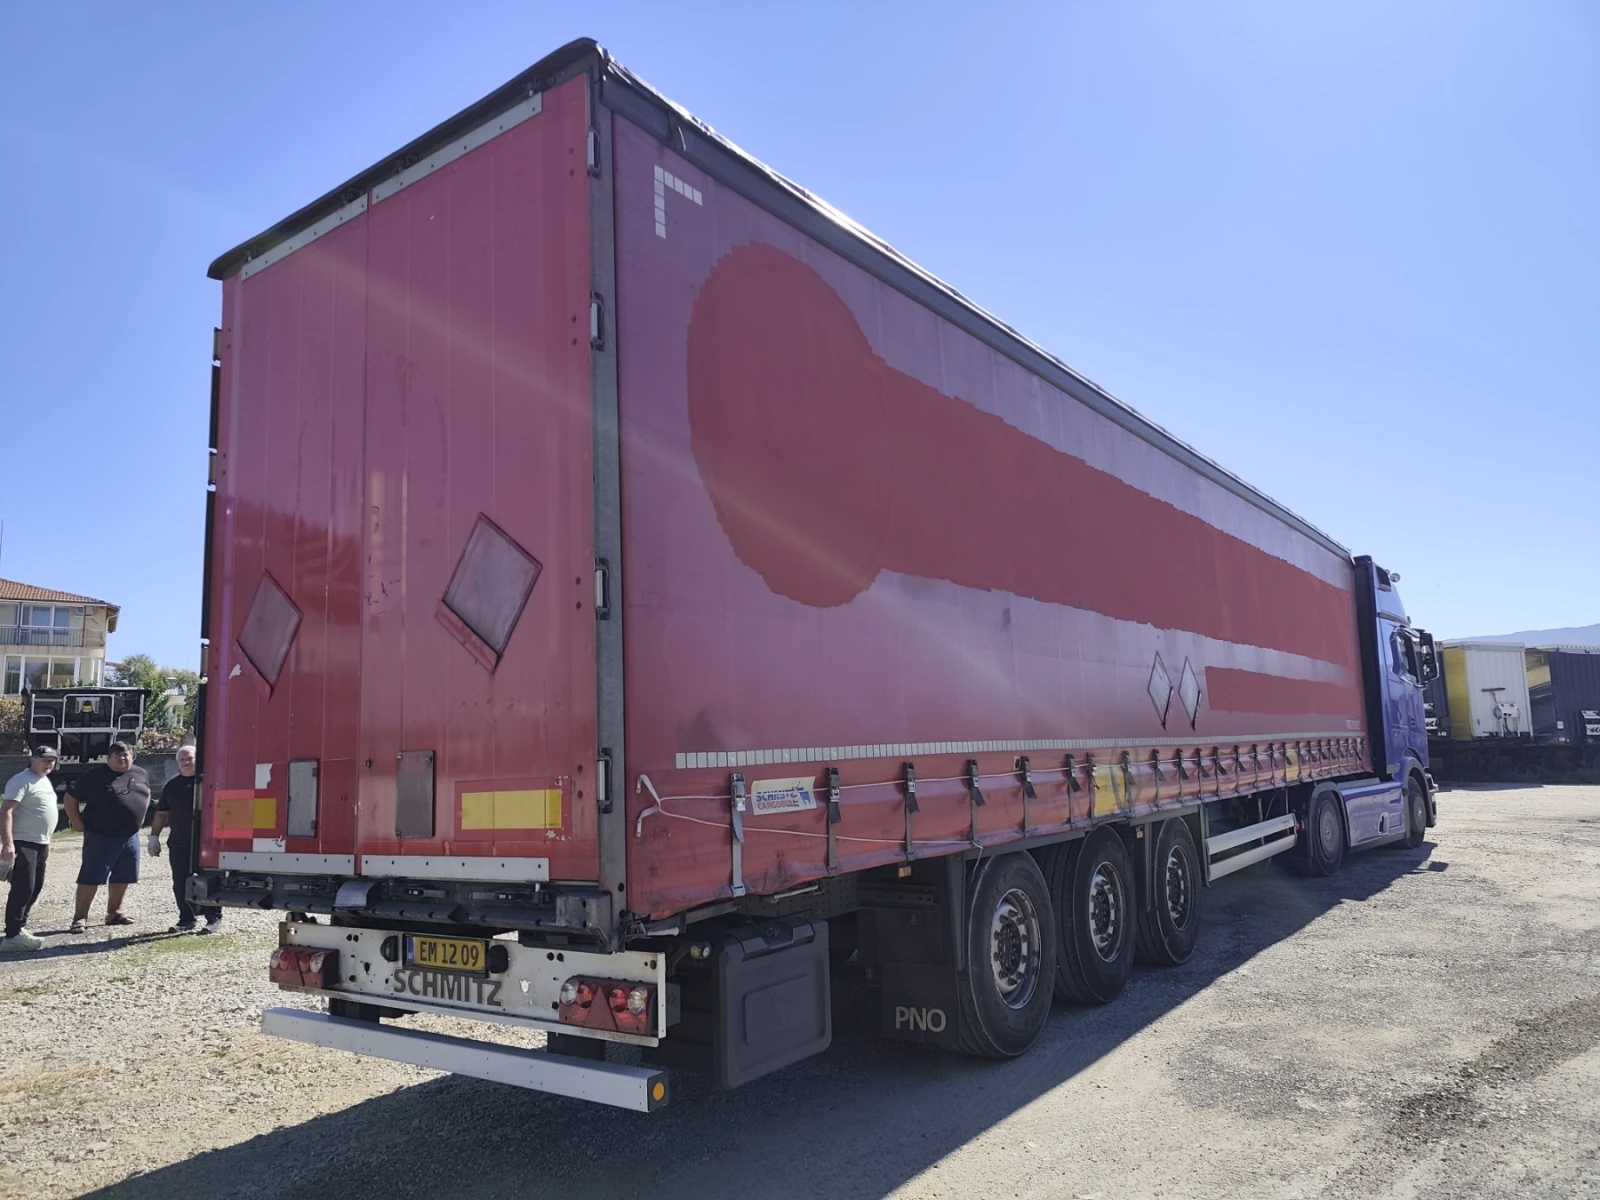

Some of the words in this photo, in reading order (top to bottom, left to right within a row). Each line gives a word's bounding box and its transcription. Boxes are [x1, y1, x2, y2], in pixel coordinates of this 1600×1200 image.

[420, 941, 438, 963] EM
[441, 943, 457, 965] 12
[461, 944, 479, 967] 09
[393, 968, 502, 1007] SCHMITZ
[895, 1006, 947, 1032] PNO
